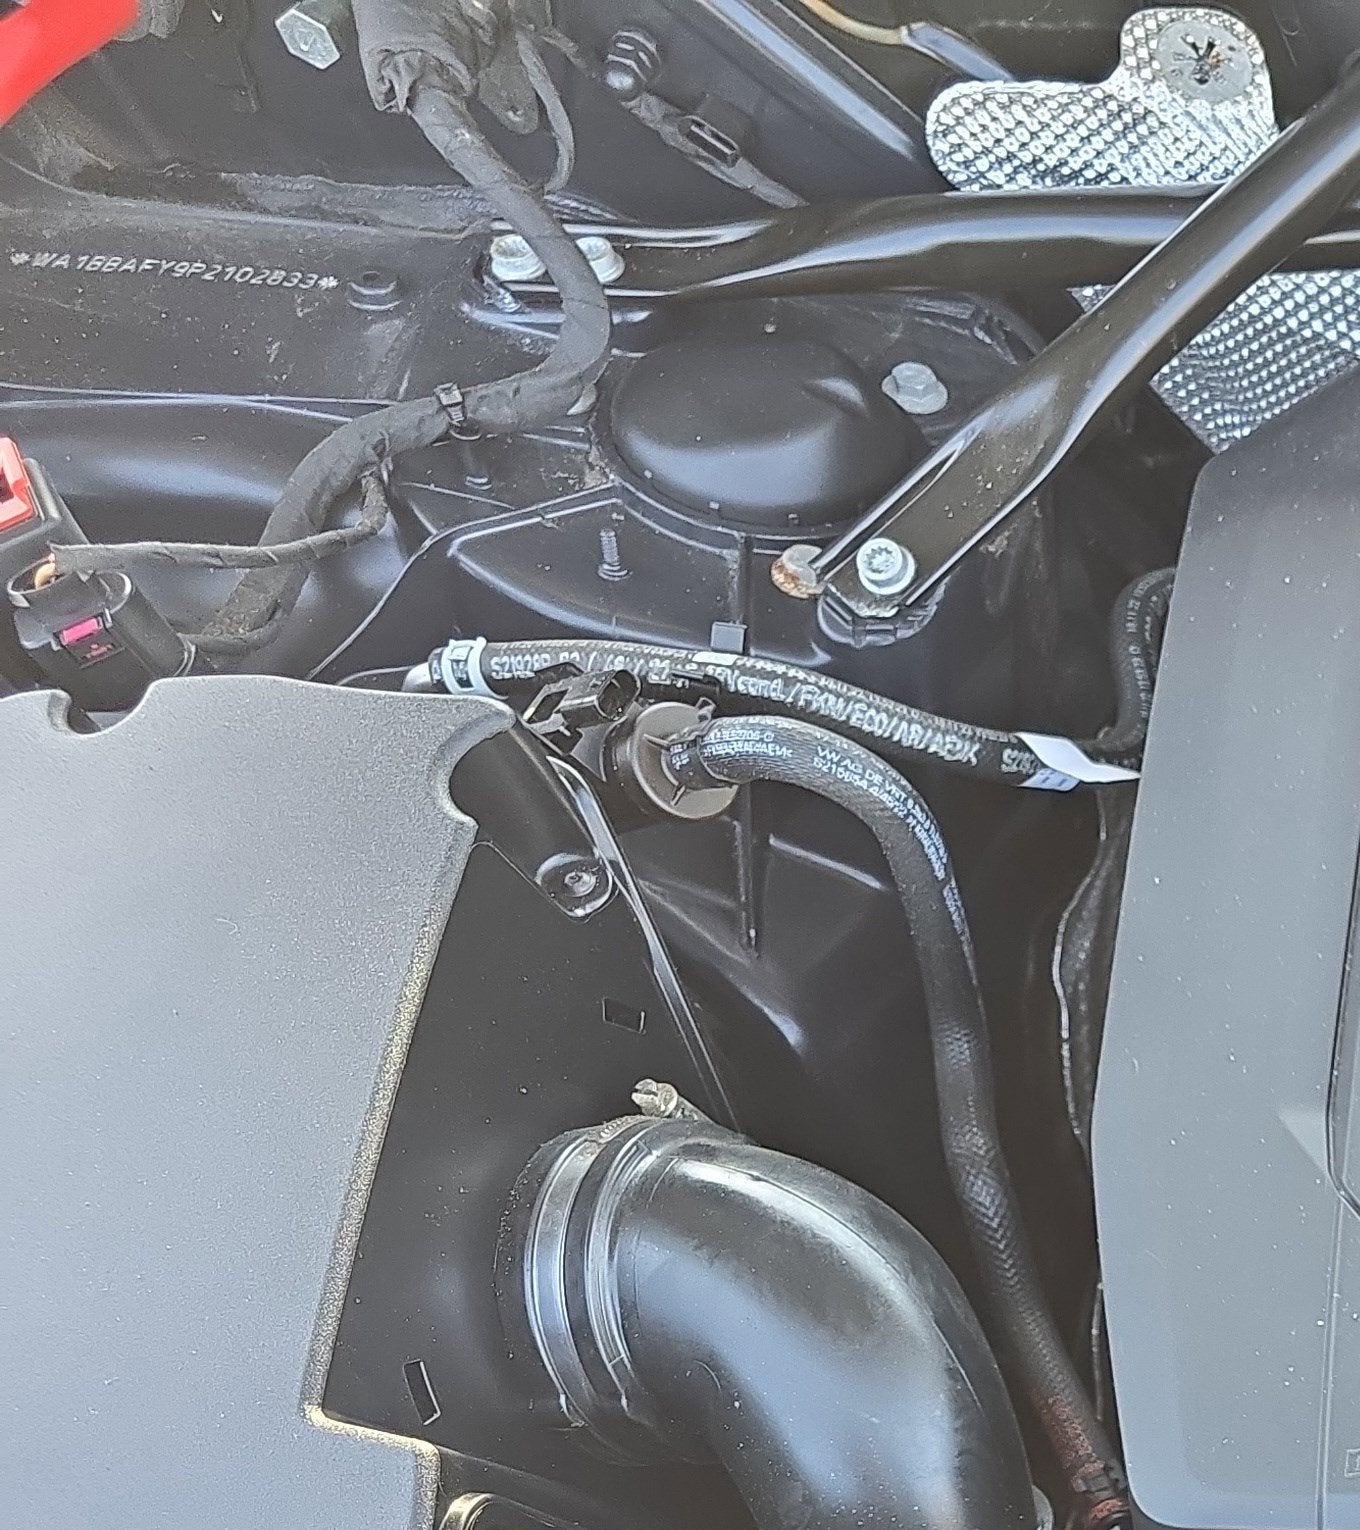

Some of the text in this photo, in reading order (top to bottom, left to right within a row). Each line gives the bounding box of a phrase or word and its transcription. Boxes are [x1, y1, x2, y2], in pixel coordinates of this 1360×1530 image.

[817, 746, 841, 763] VW
[841, 758, 863, 774] AG
[865, 769, 883, 786] DE
